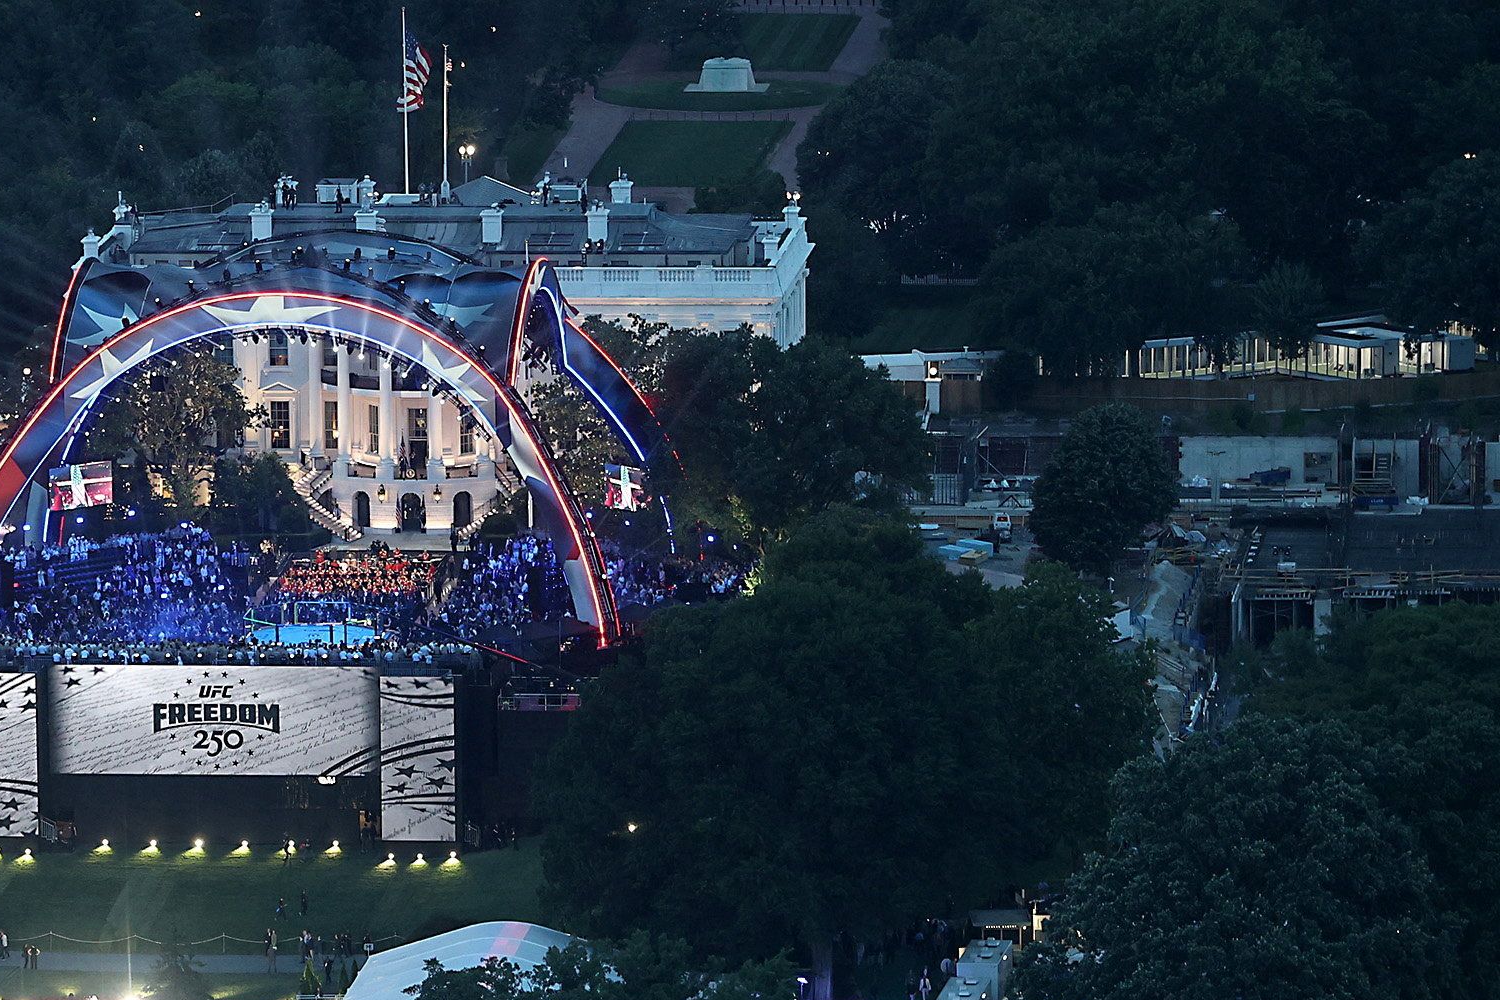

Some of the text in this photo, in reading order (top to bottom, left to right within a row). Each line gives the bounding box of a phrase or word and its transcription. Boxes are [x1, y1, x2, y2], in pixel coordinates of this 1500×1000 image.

[199, 685, 234, 698] UFC
[152, 703, 280, 734] FREEDOM
[192, 729, 244, 757] 250
